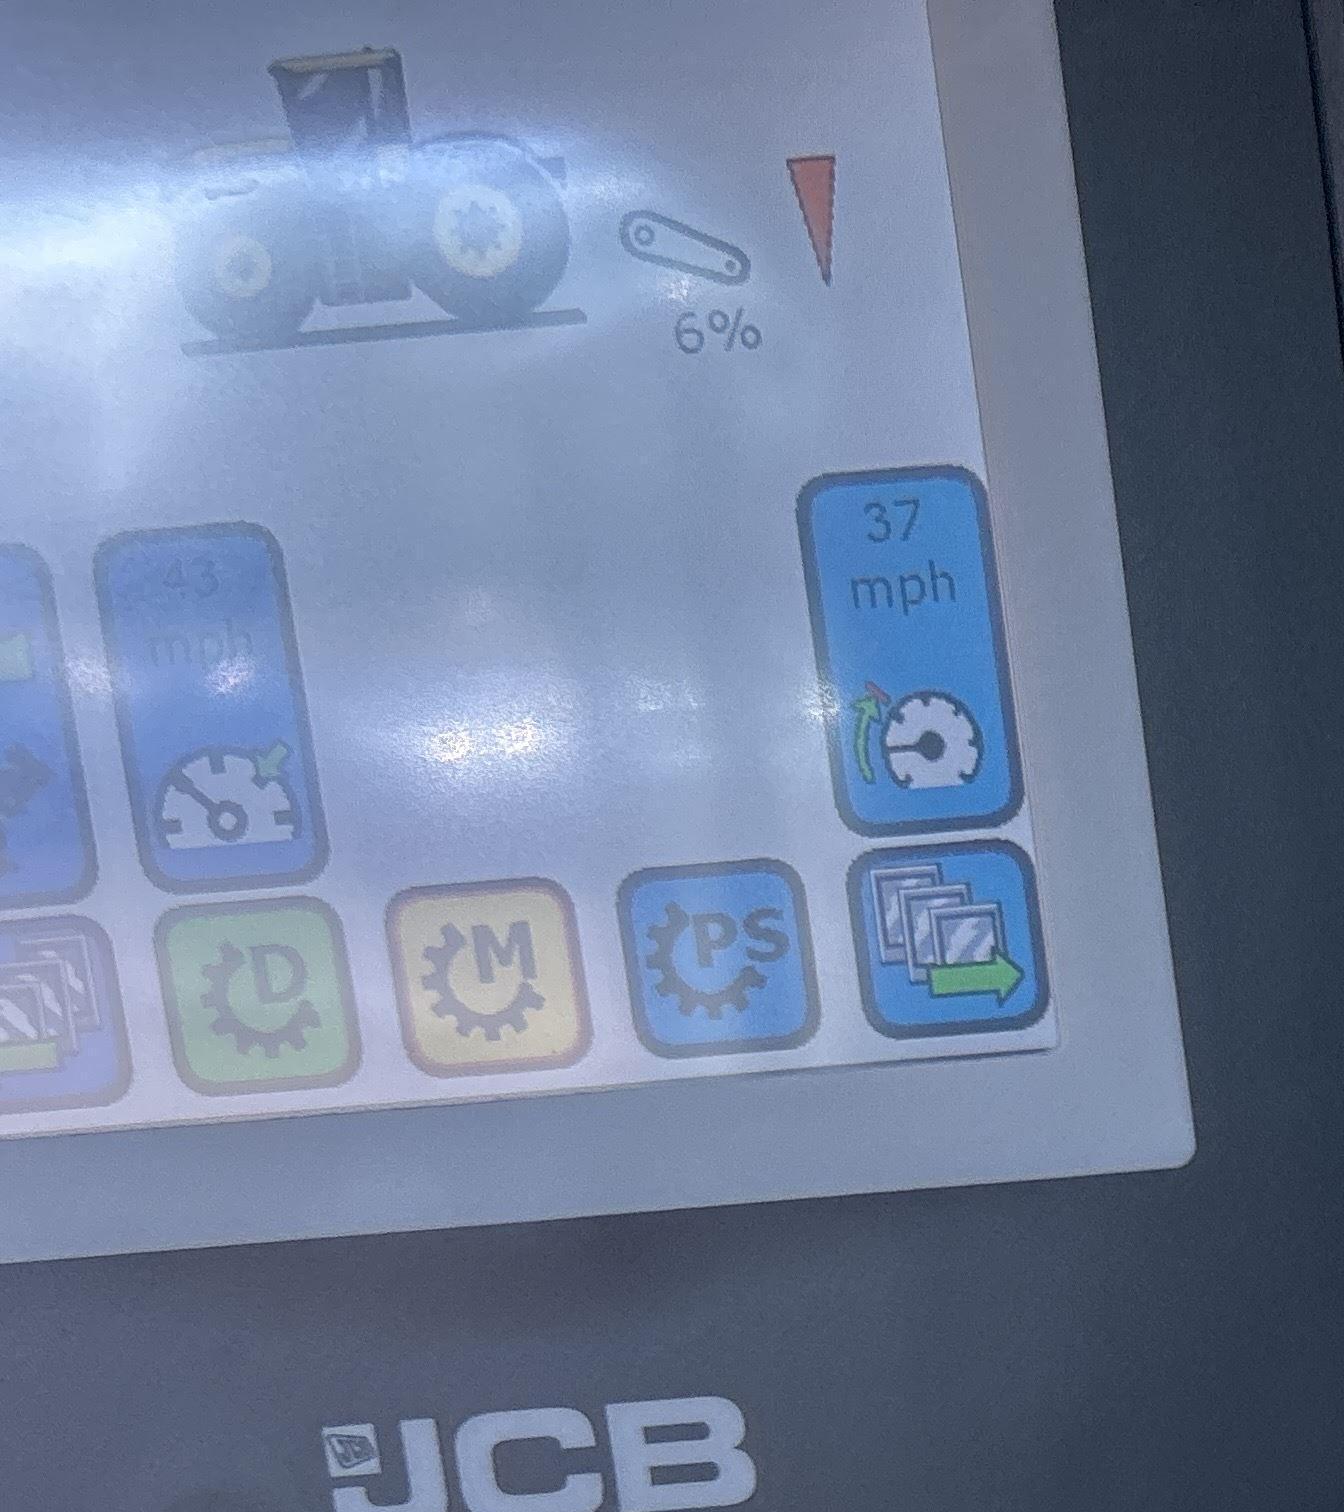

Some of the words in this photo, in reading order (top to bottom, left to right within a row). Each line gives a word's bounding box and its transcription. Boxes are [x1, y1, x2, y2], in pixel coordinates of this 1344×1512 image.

[674, 307, 763, 355] 6%
[863, 499, 922, 543] 37
[850, 560, 958, 616] mph
[146, 617, 254, 670] mph
[471, 920, 538, 984] M
[692, 907, 791, 968] PS
[249, 943, 309, 1006] D
